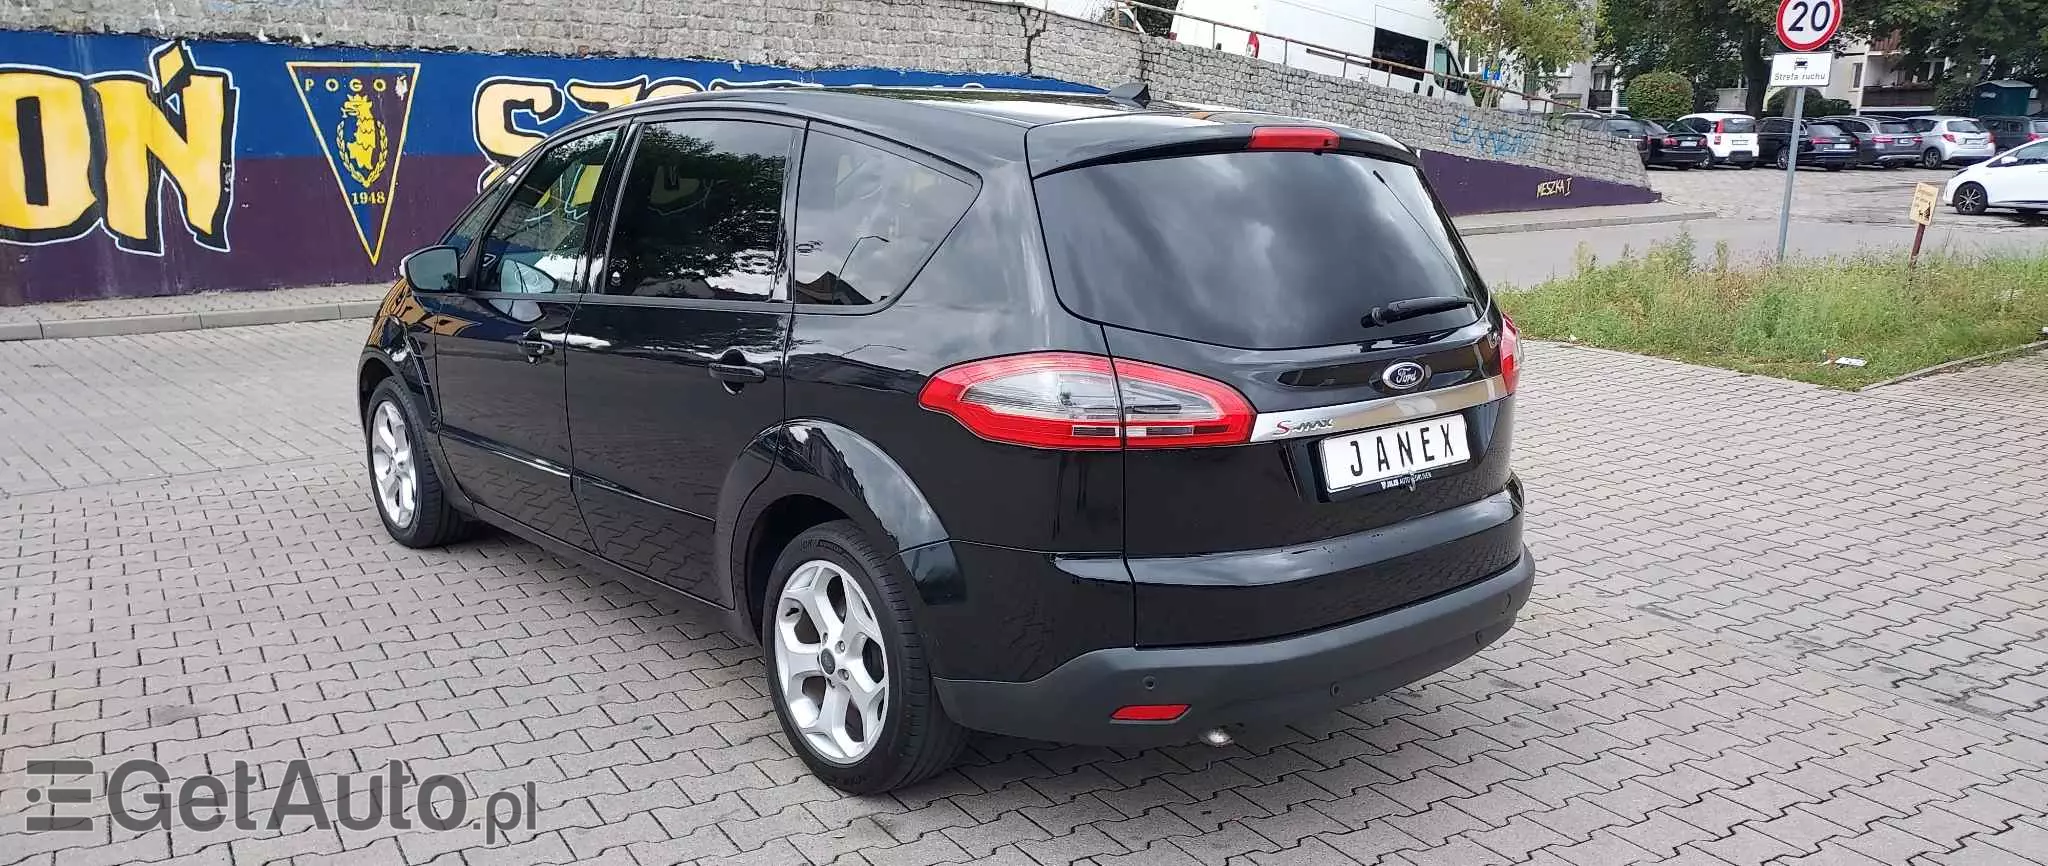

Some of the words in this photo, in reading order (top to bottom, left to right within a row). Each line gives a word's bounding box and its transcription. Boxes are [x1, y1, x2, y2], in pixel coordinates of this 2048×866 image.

[1788, 1, 1831, 32] 20
[1774, 72, 1799, 81] Strefa
[1802, 71, 1826, 80] ruchu
[350, 191, 386, 205] 1948
[1395, 367, 1417, 384] Ford
[1350, 423, 1454, 477] JANEX
